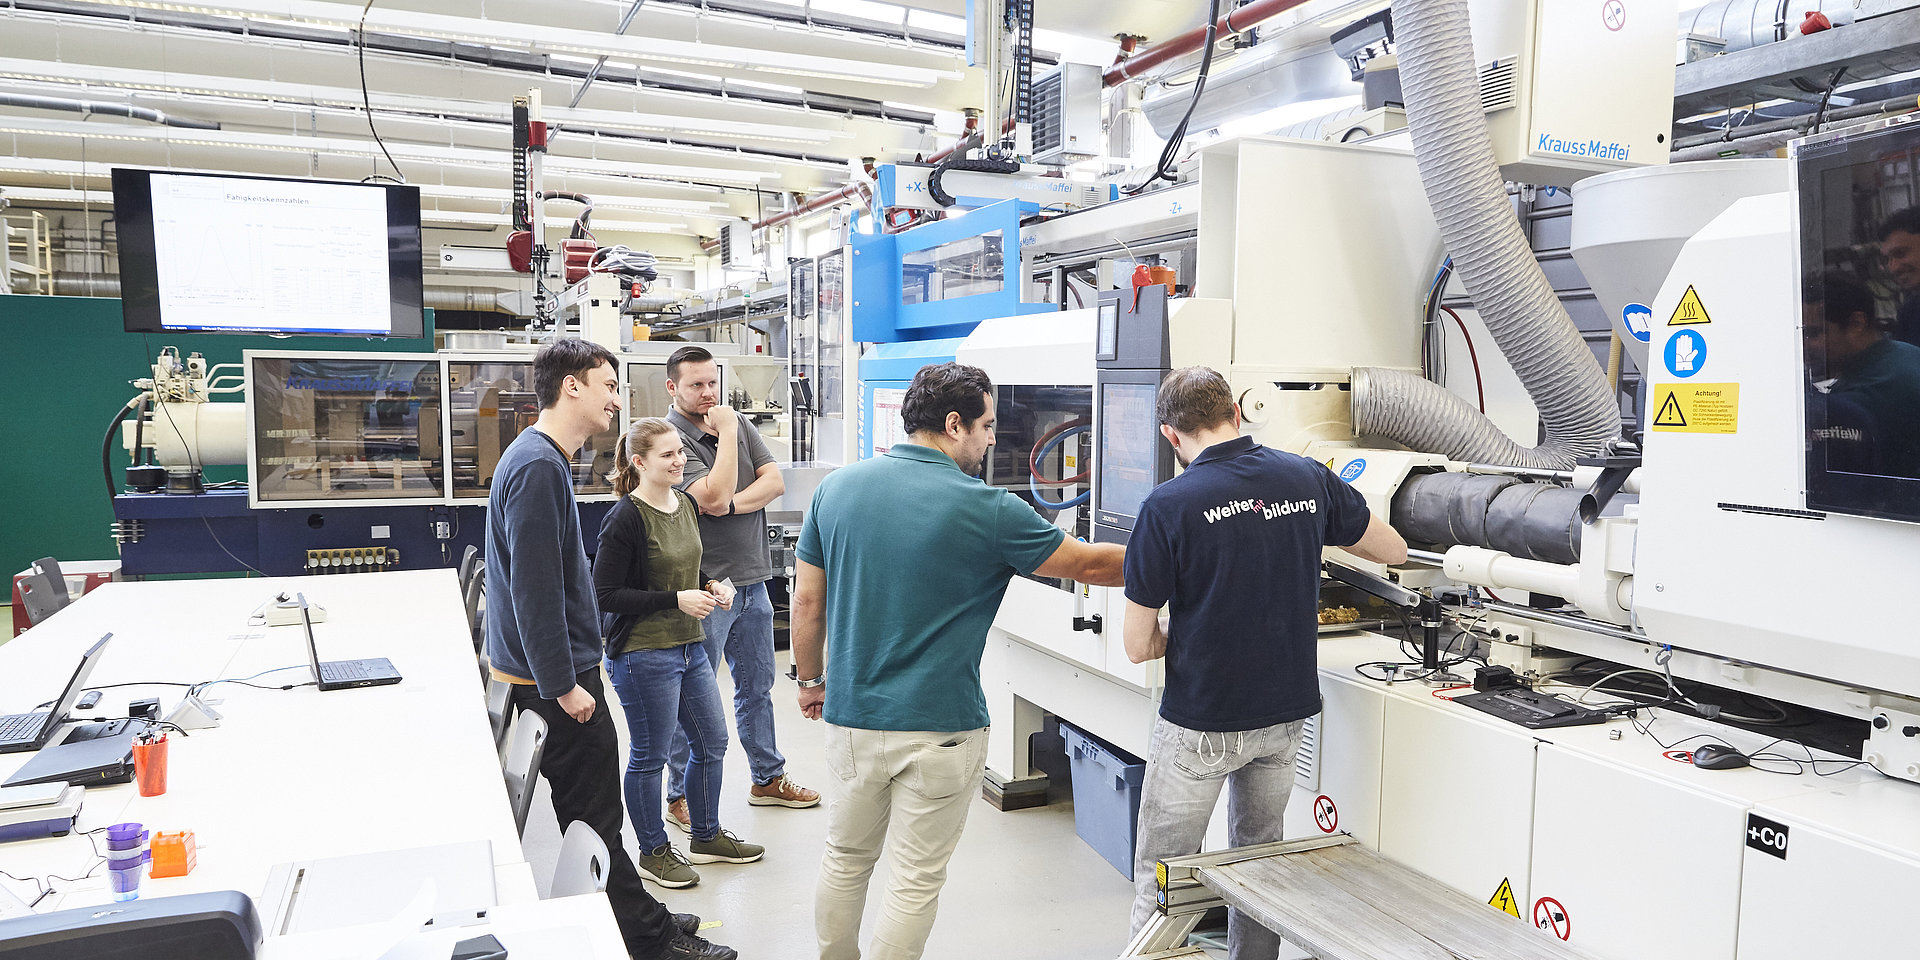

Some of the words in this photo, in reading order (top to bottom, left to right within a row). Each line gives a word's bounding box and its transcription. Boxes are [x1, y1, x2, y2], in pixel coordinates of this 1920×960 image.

[1203, 498, 1254, 524] Weiter
[1252, 499, 1265, 514] mit
[1262, 498, 1317, 521] bildung
